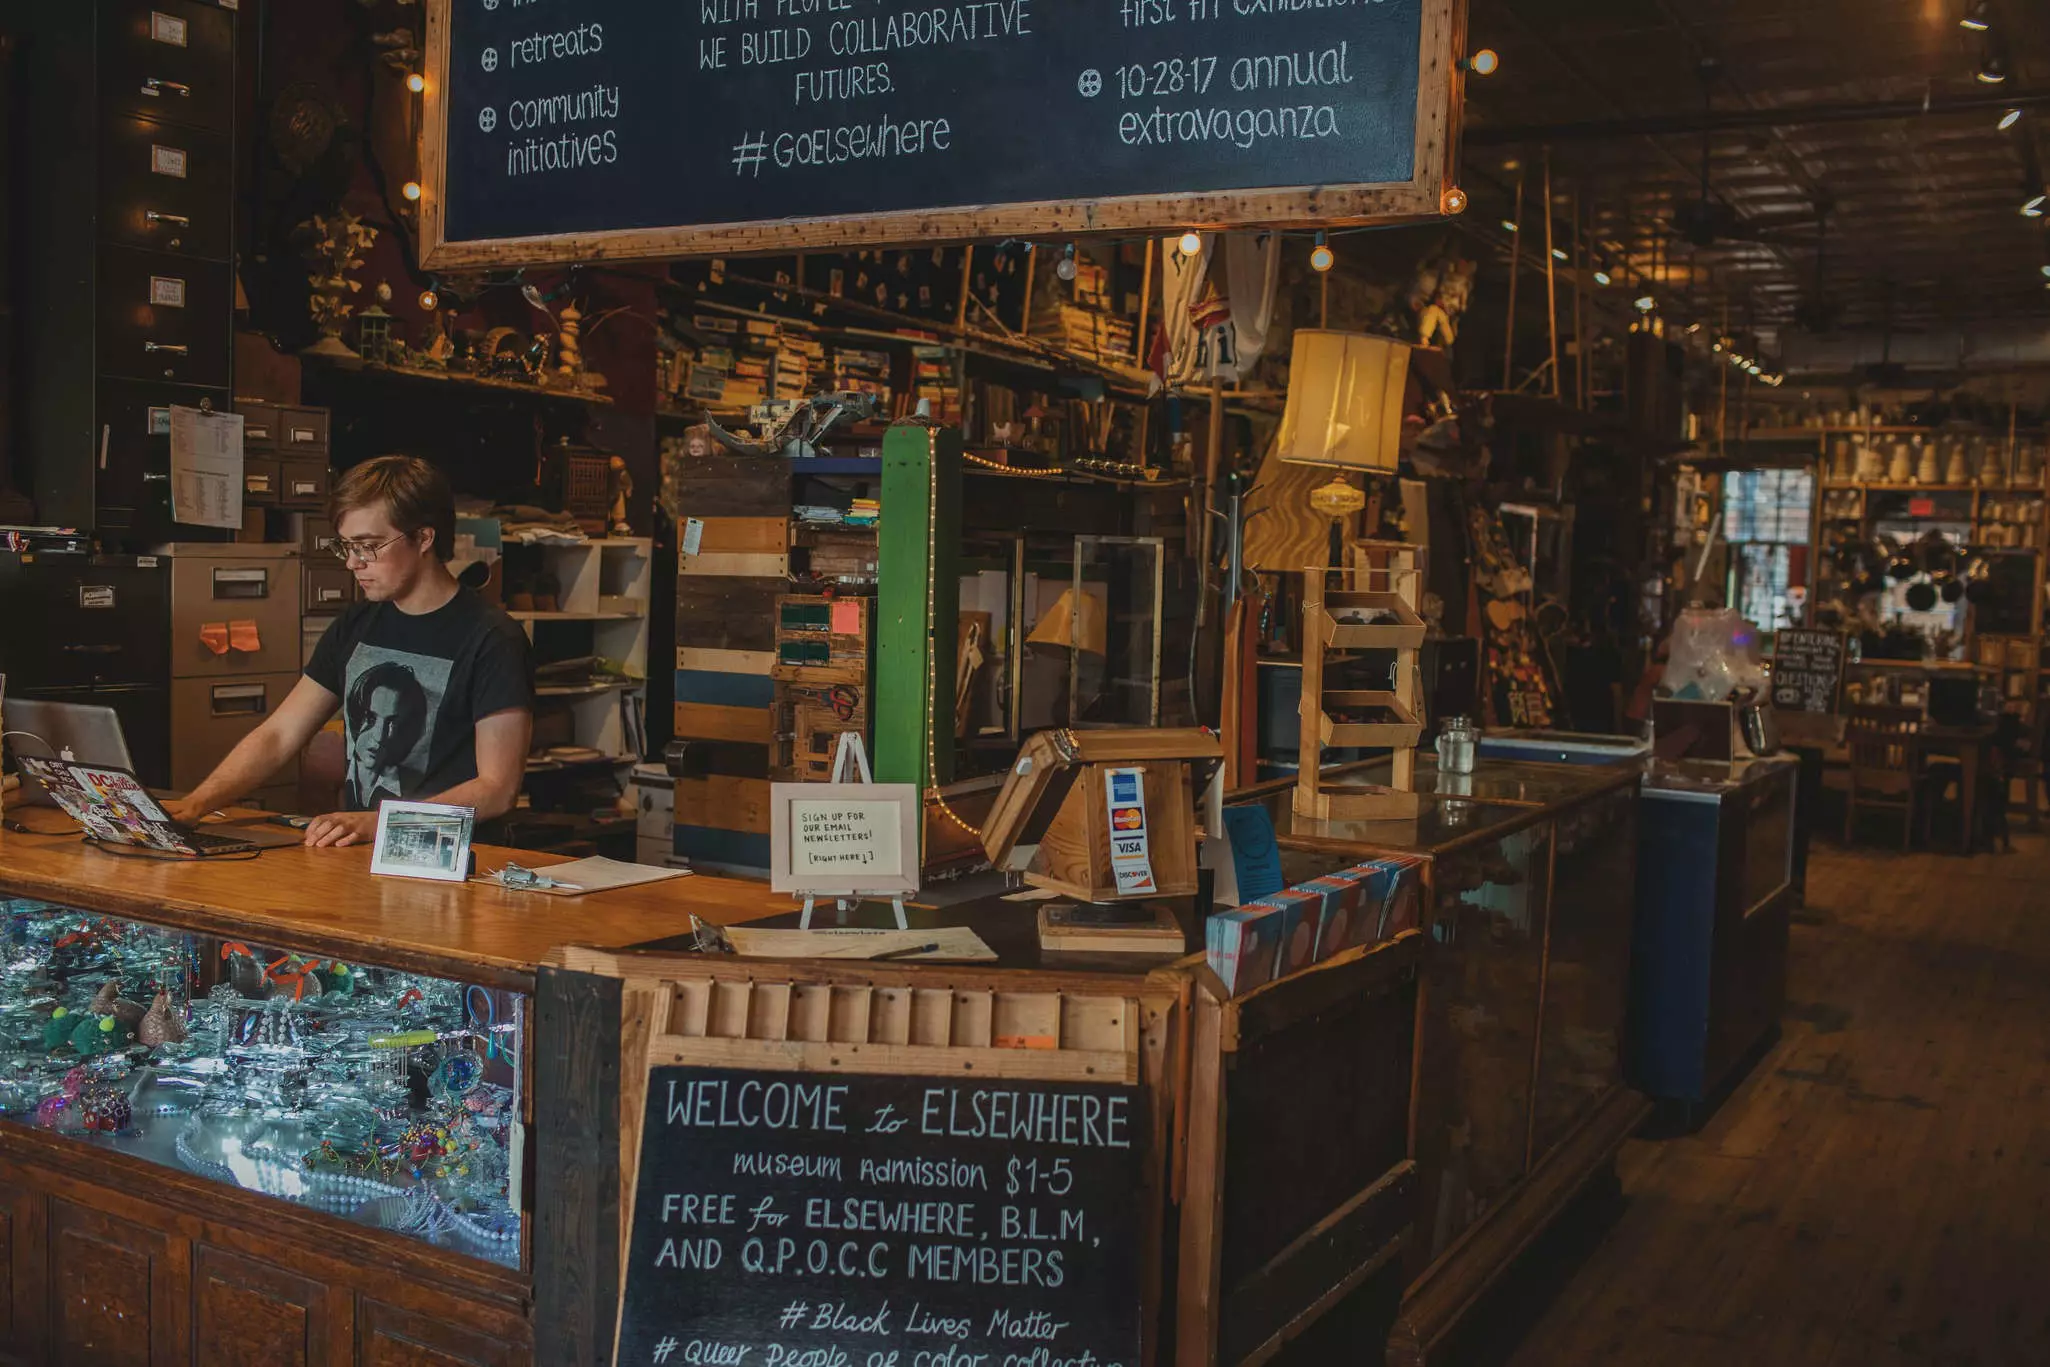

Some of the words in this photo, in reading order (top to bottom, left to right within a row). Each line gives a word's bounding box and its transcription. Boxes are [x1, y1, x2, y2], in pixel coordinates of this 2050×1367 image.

[511, 23, 603, 68] retreats
[700, 37, 727, 70] WE
[742, 27, 812, 65] BUILD
[829, 0, 1033, 56] COLLABORATIVE
[795, 62, 895, 106] FUTURES.
[1115, 56, 1218, 99] 10-28-17
[1230, 40, 1354, 91] annual
[508, 84, 620, 131] community
[1119, 105, 1341, 149] extravaganza
[508, 129, 618, 177] initiatives
[802, 813, 828, 822] SIGN
[831, 812, 843, 821] UP
[847, 812, 865, 821] FOR
[803, 824, 820, 832] OUR
[824, 823, 852, 832] EMAIL
[804, 830, 872, 843] NEWSLETTERS!
[1119, 842, 1142, 854] VISA
[666, 1080, 849, 1134] WELCOME
[865, 1102, 909, 1135] to
[920, 1088, 1131, 1150] ELSEWHERE
[733, 1152, 842, 1183] museum
[860, 1155, 987, 1192] Admission
[1005, 1154, 1073, 1196] $1-5
[661, 1194, 737, 1225] FREE
[747, 1195, 790, 1233] for
[805, 1198, 989, 1241] ELSEWHERE,
[654, 1238, 722, 1271] AND
[740, 1237, 889, 1277] Q.P.O.C.C
[908, 1244, 1065, 1288] MEMBERS
[905, 1302, 972, 1339] Lives
[987, 1308, 1070, 1341] Matter
[914, 1343, 989, 1367] color
